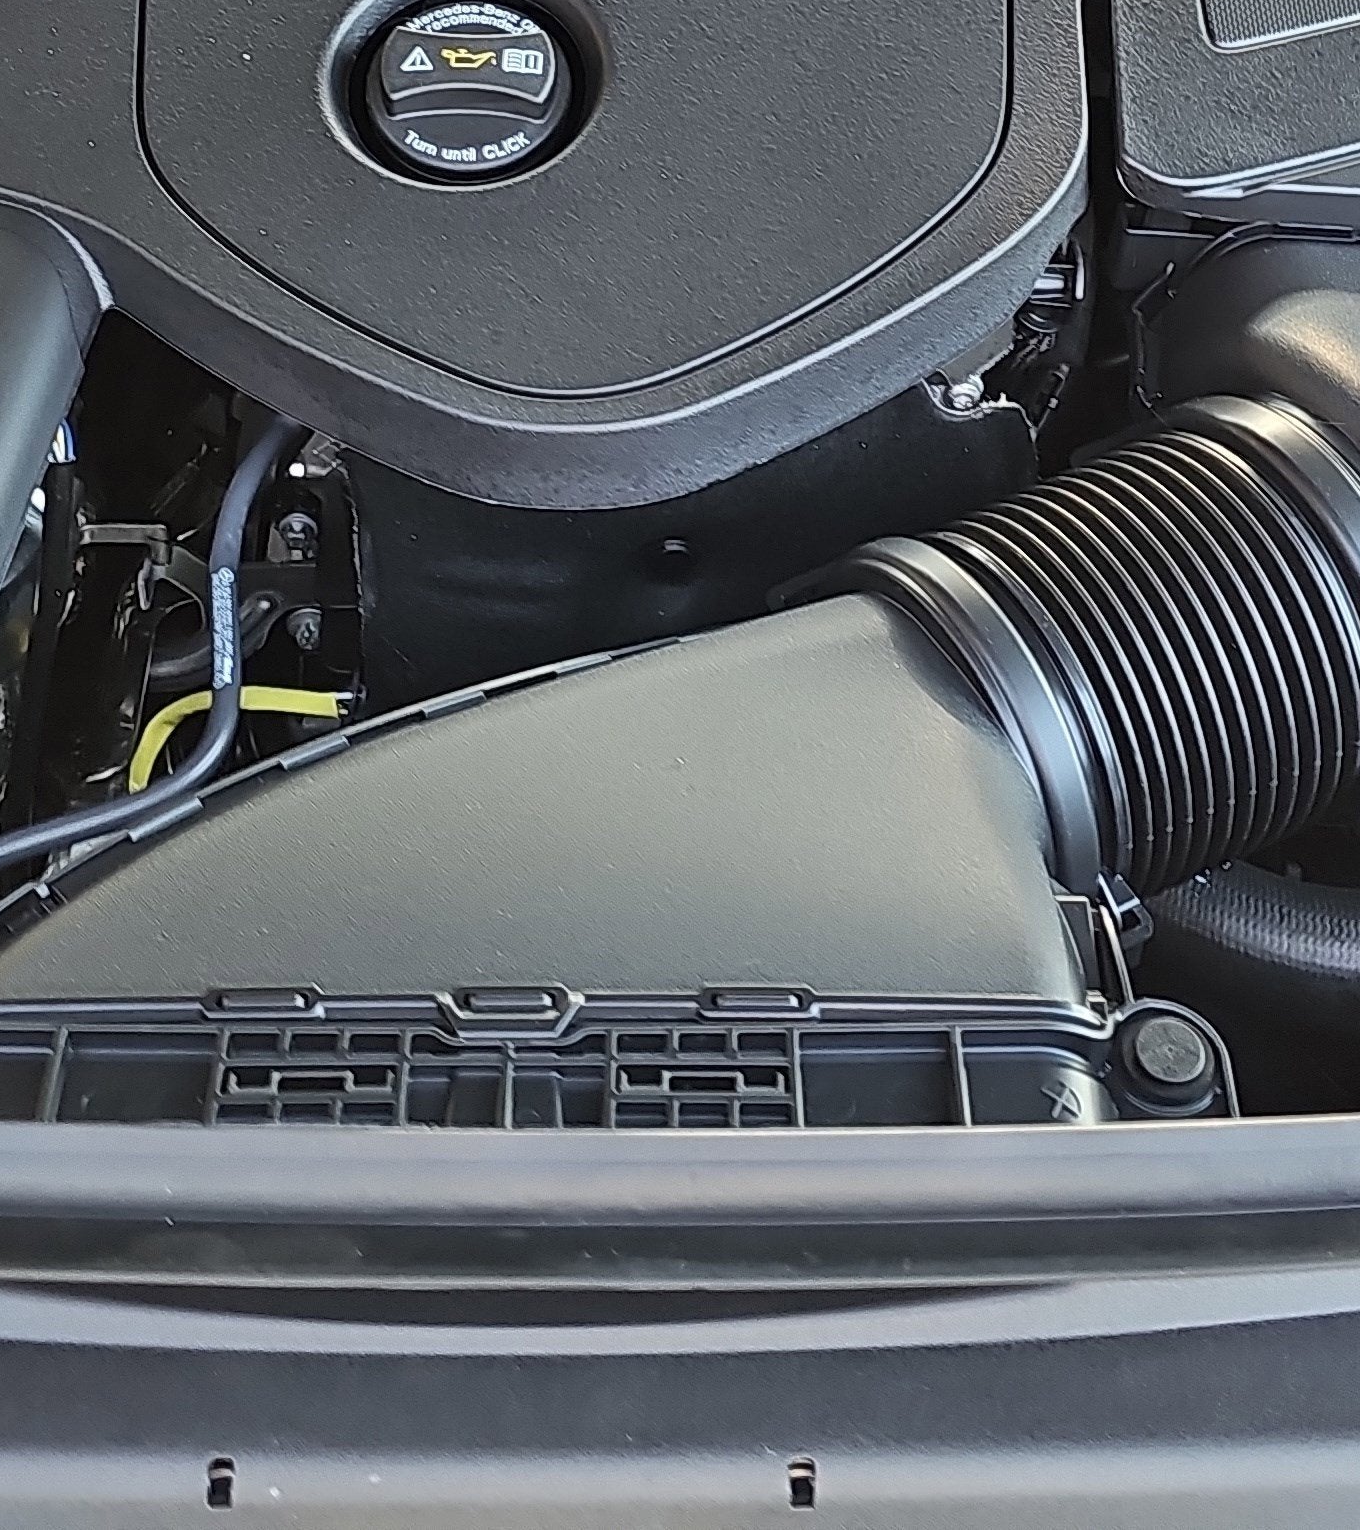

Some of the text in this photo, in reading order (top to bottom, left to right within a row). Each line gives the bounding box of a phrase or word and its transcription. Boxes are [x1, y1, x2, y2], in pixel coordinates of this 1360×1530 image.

[406, 3, 521, 30] Mercedes-Benz
[425, 13, 523, 34] recommended
[404, 129, 531, 162] Turn until CLICK
